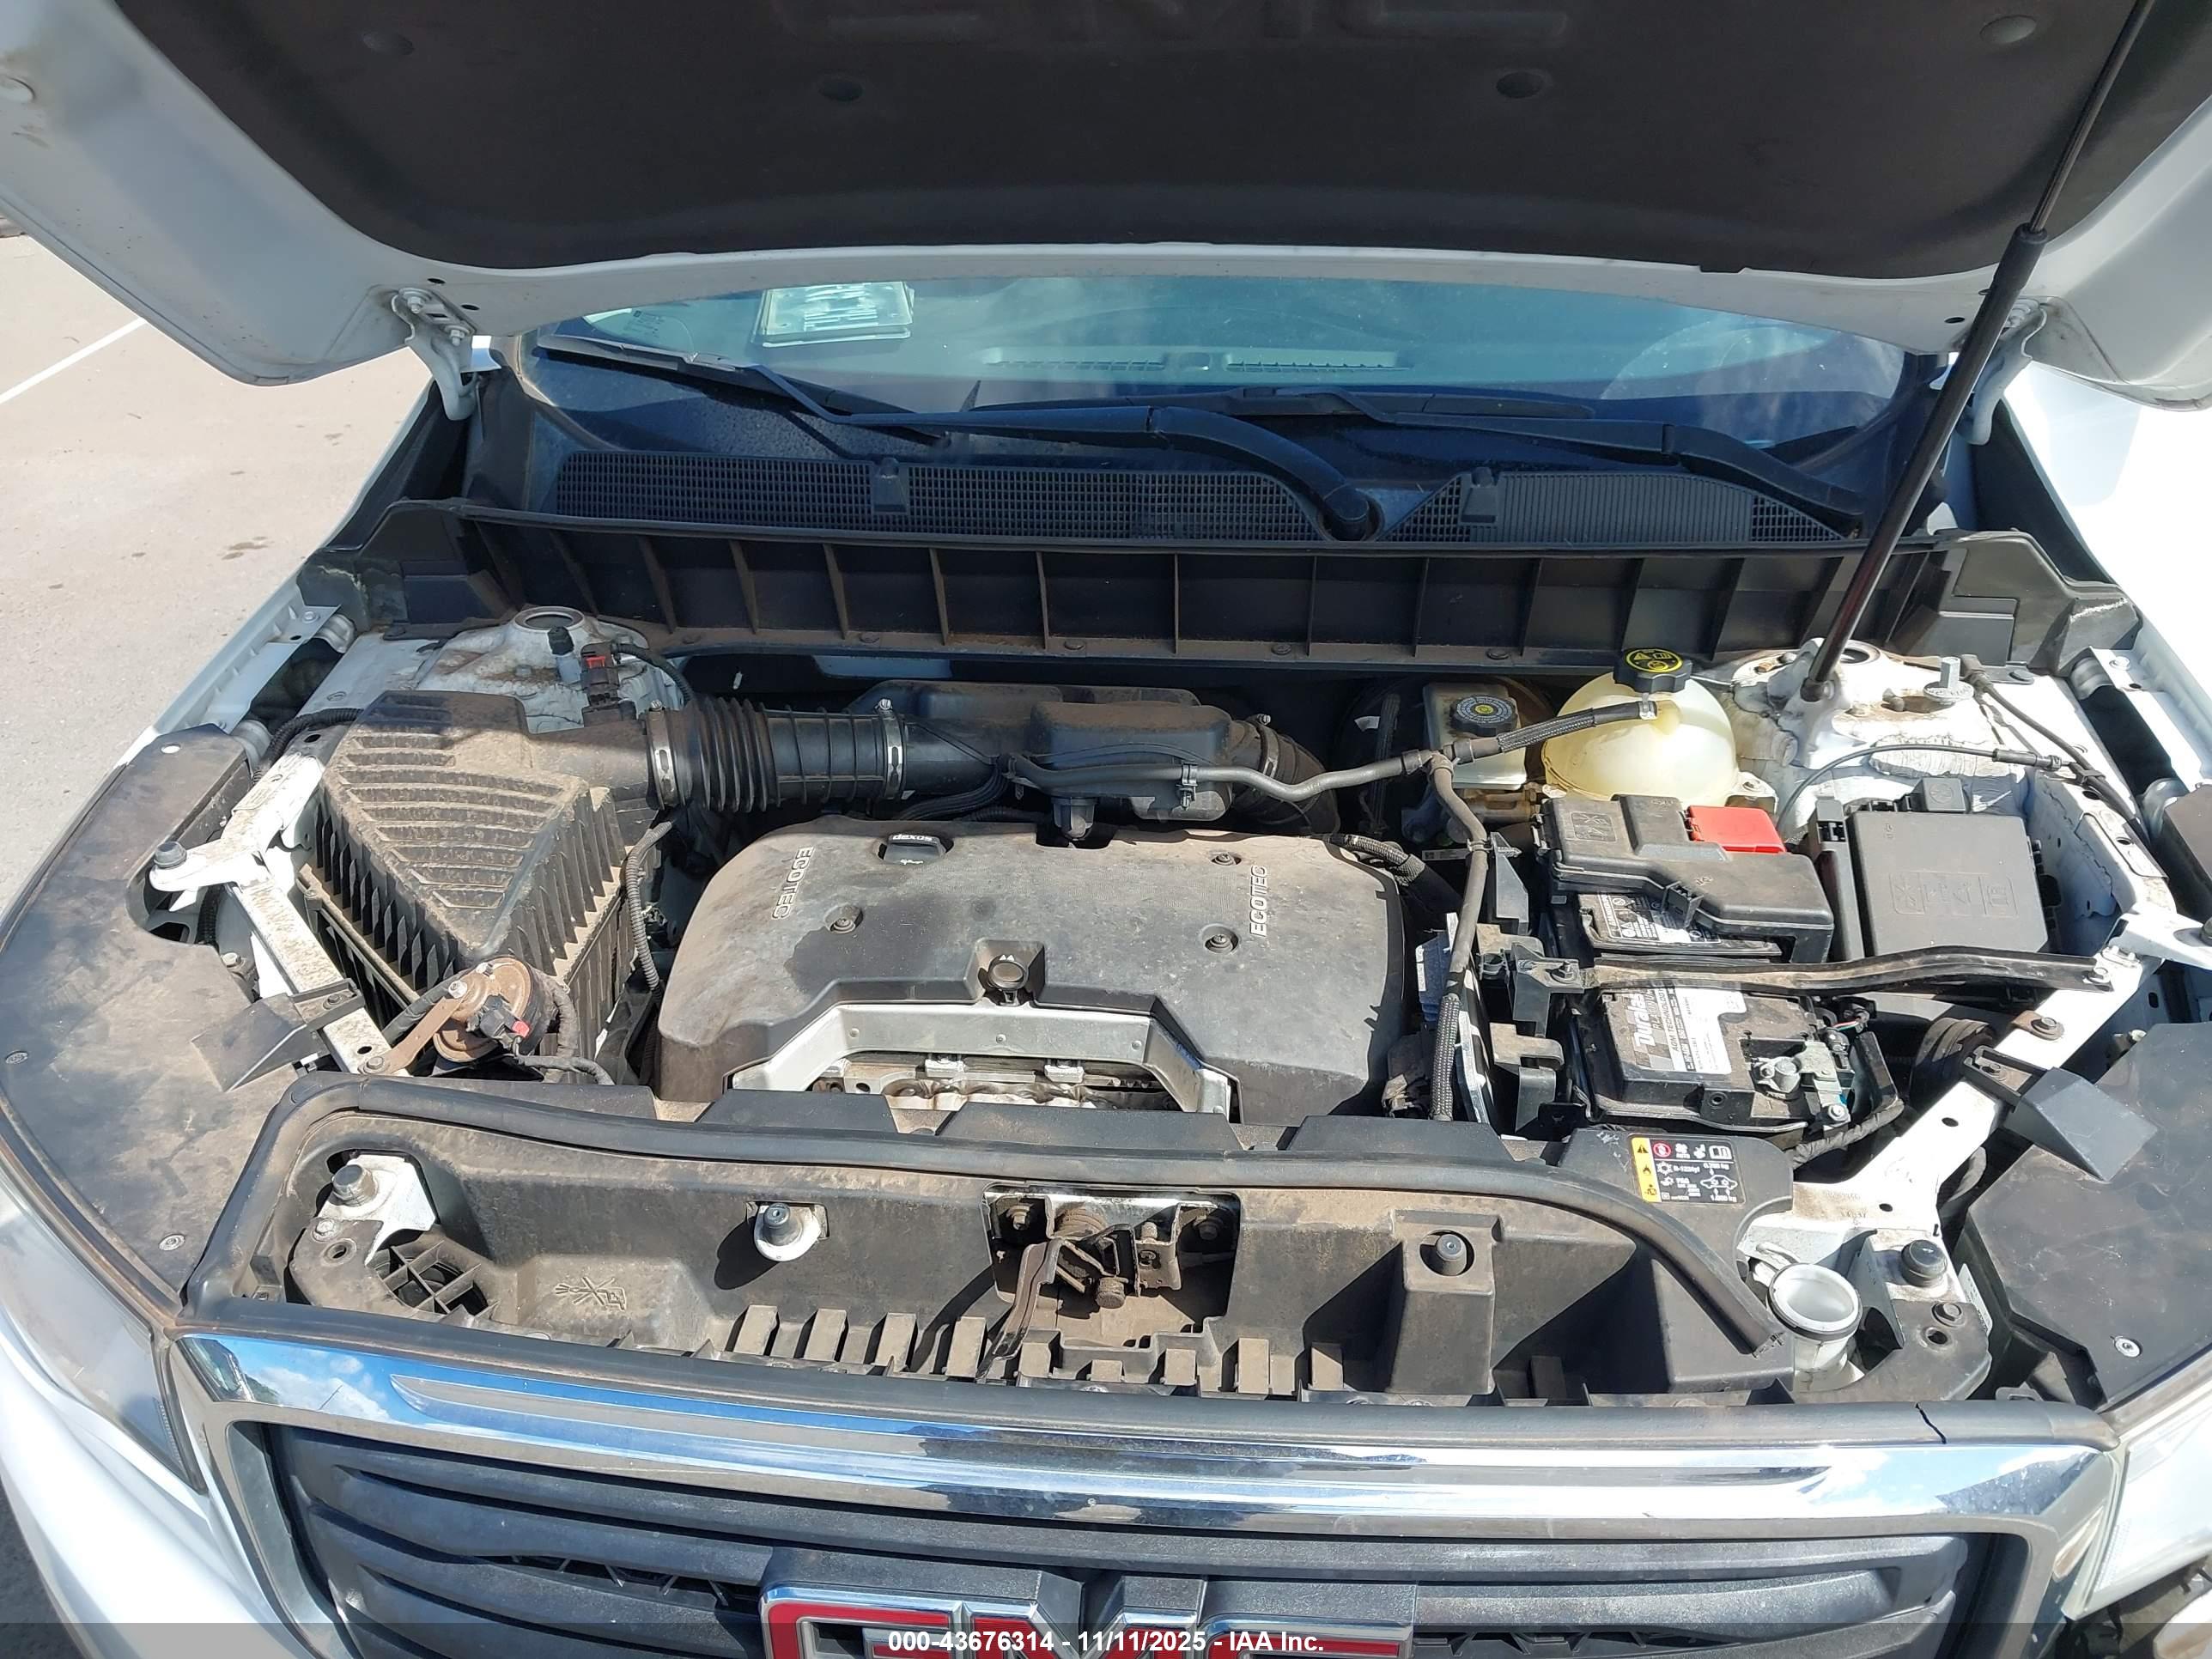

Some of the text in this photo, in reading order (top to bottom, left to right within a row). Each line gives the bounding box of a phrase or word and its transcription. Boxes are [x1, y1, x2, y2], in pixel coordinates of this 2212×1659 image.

[773, 846, 815, 920] ECOTEC
[1249, 866, 1268, 938] ECOTEC
[1668, 1035, 1680, 1052] AGM
